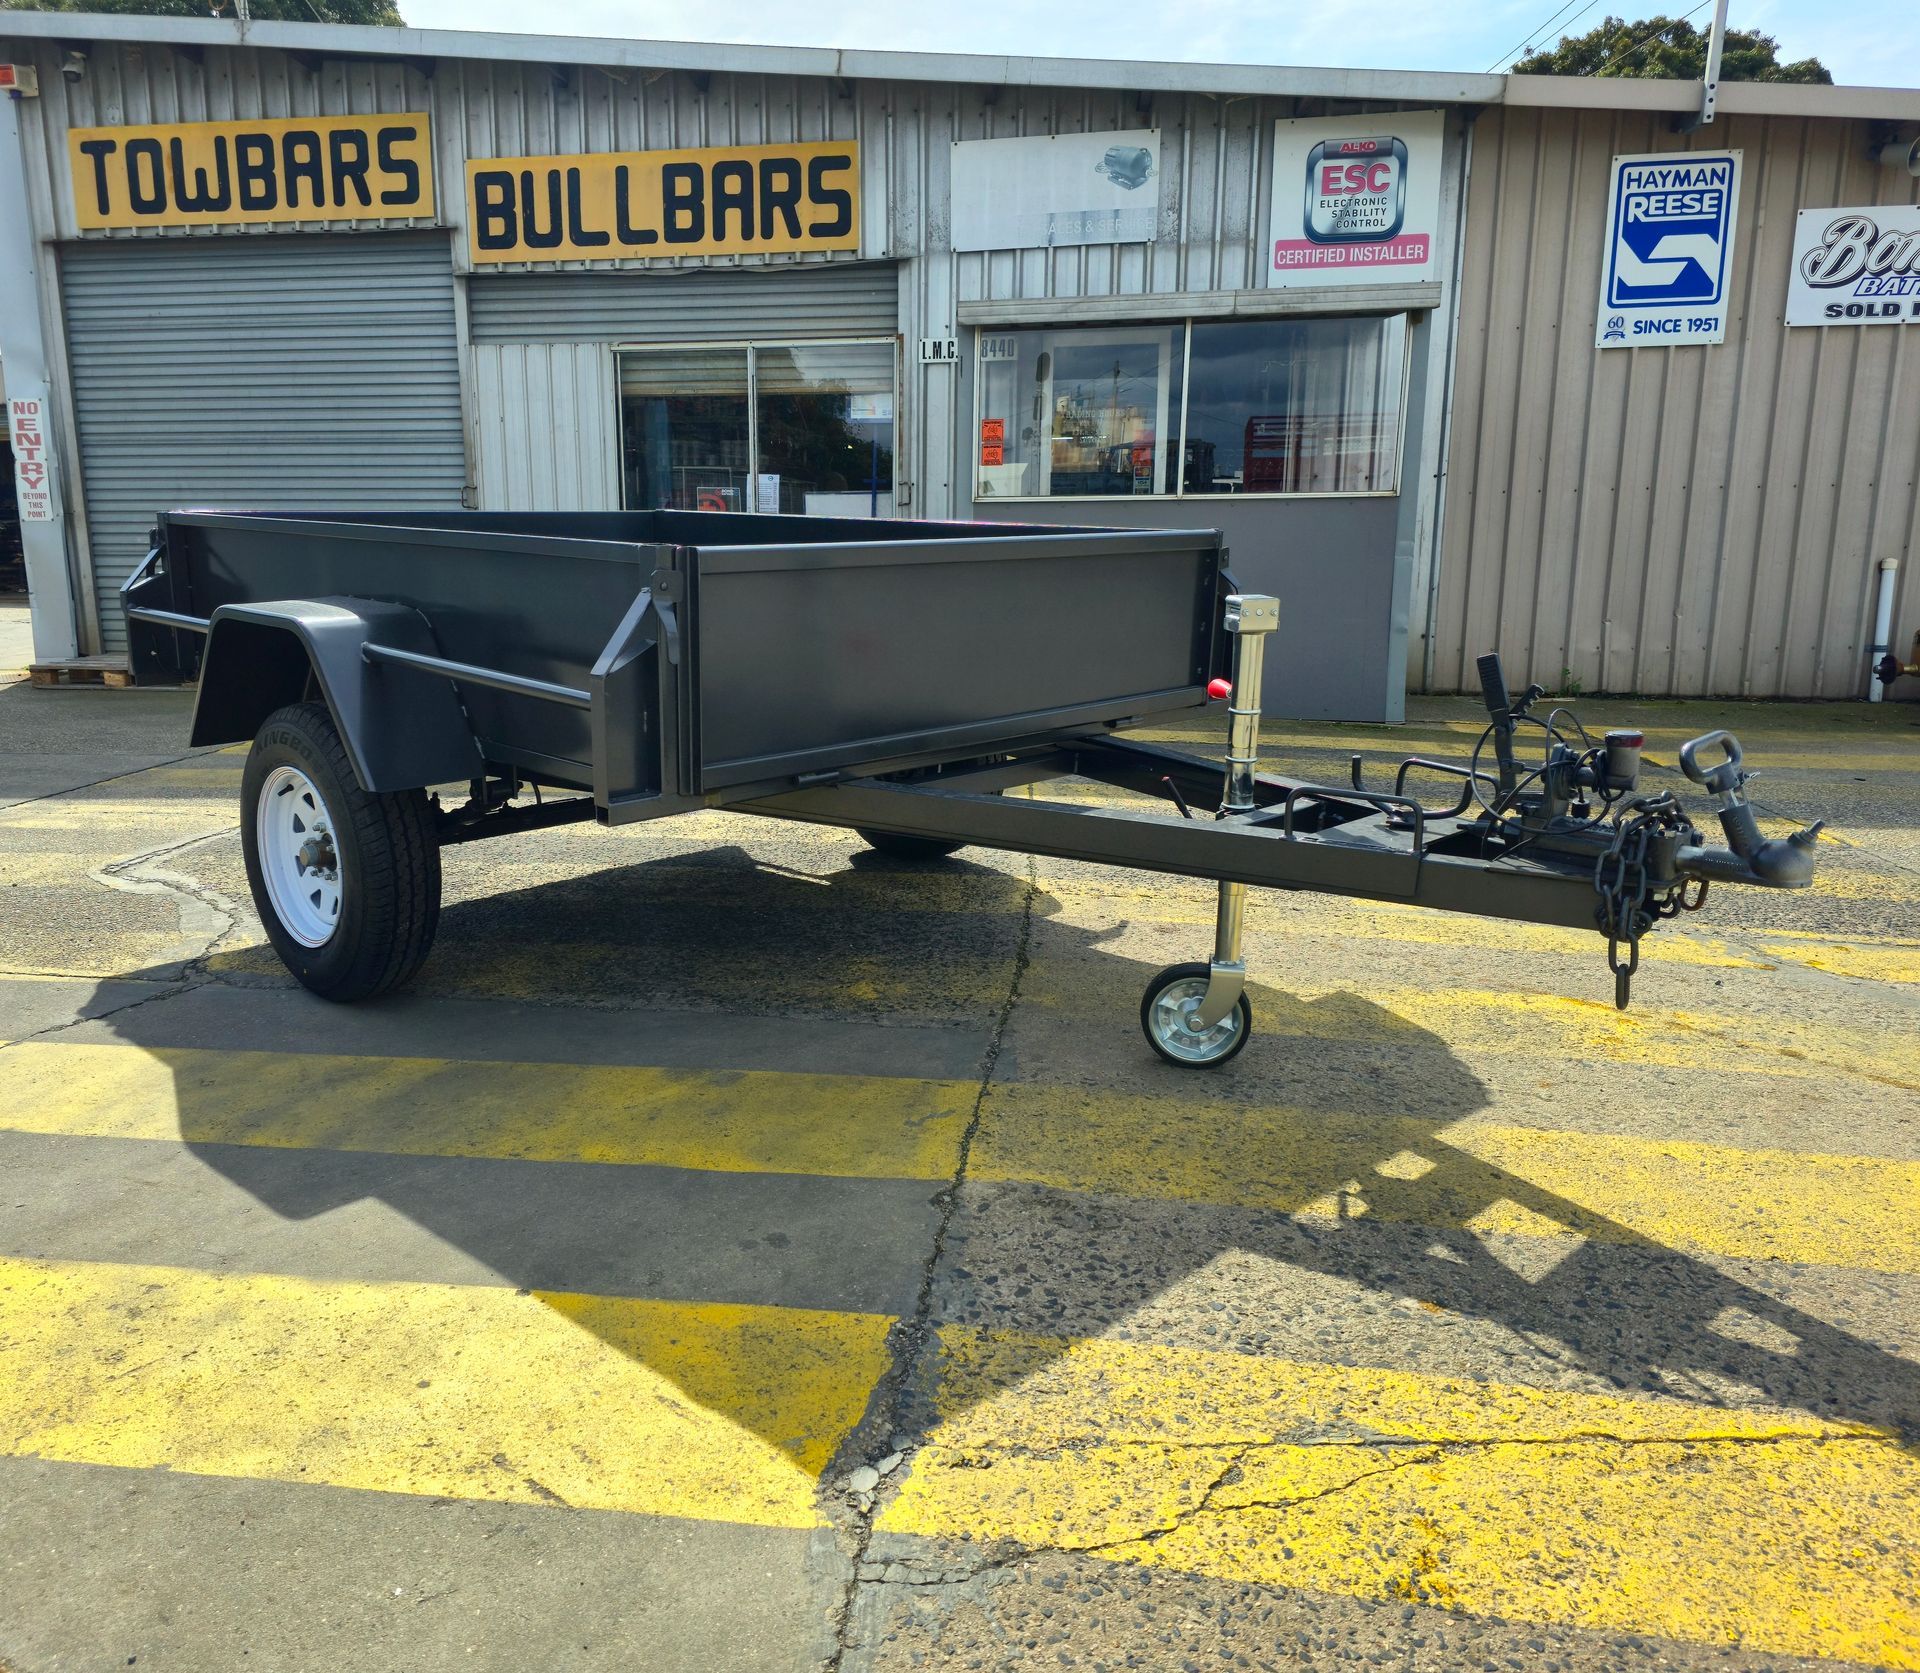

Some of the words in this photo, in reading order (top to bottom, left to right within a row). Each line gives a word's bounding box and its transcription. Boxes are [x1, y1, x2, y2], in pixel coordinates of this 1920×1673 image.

[1339, 141, 1377, 153] AL-KO
[80, 126, 420, 215] TOWBARS
[1626, 167, 1727, 189] HAYMAN
[1320, 163, 1391, 196] ESC
[474, 155, 852, 250] BULLBARS
[1320, 197, 1387, 208] ELECTRONIC
[1627, 192, 1720, 223] REESE
[1331, 207, 1387, 218] STABILITY
[1085, 219, 1094, 233] &
[1336, 218, 1386, 228] CONTROL
[1277, 248, 1346, 264] CERTIFIED
[1350, 245, 1424, 262] INSTALLER
[1853, 276, 1920, 296] BAT
[1825, 302, 1901, 318] SOLD
[1608, 315, 1624, 329] 60
[1633, 318, 1682, 334] SINCE
[1687, 317, 1719, 332] 1951
[981, 339, 1014, 358] 8440
[13, 402, 38, 414] NO
[16, 418, 45, 489] ENTRY
[23, 492, 47, 500] BEYOND
[28, 501, 43, 509] THIS
[28, 510, 46, 518] POINT
